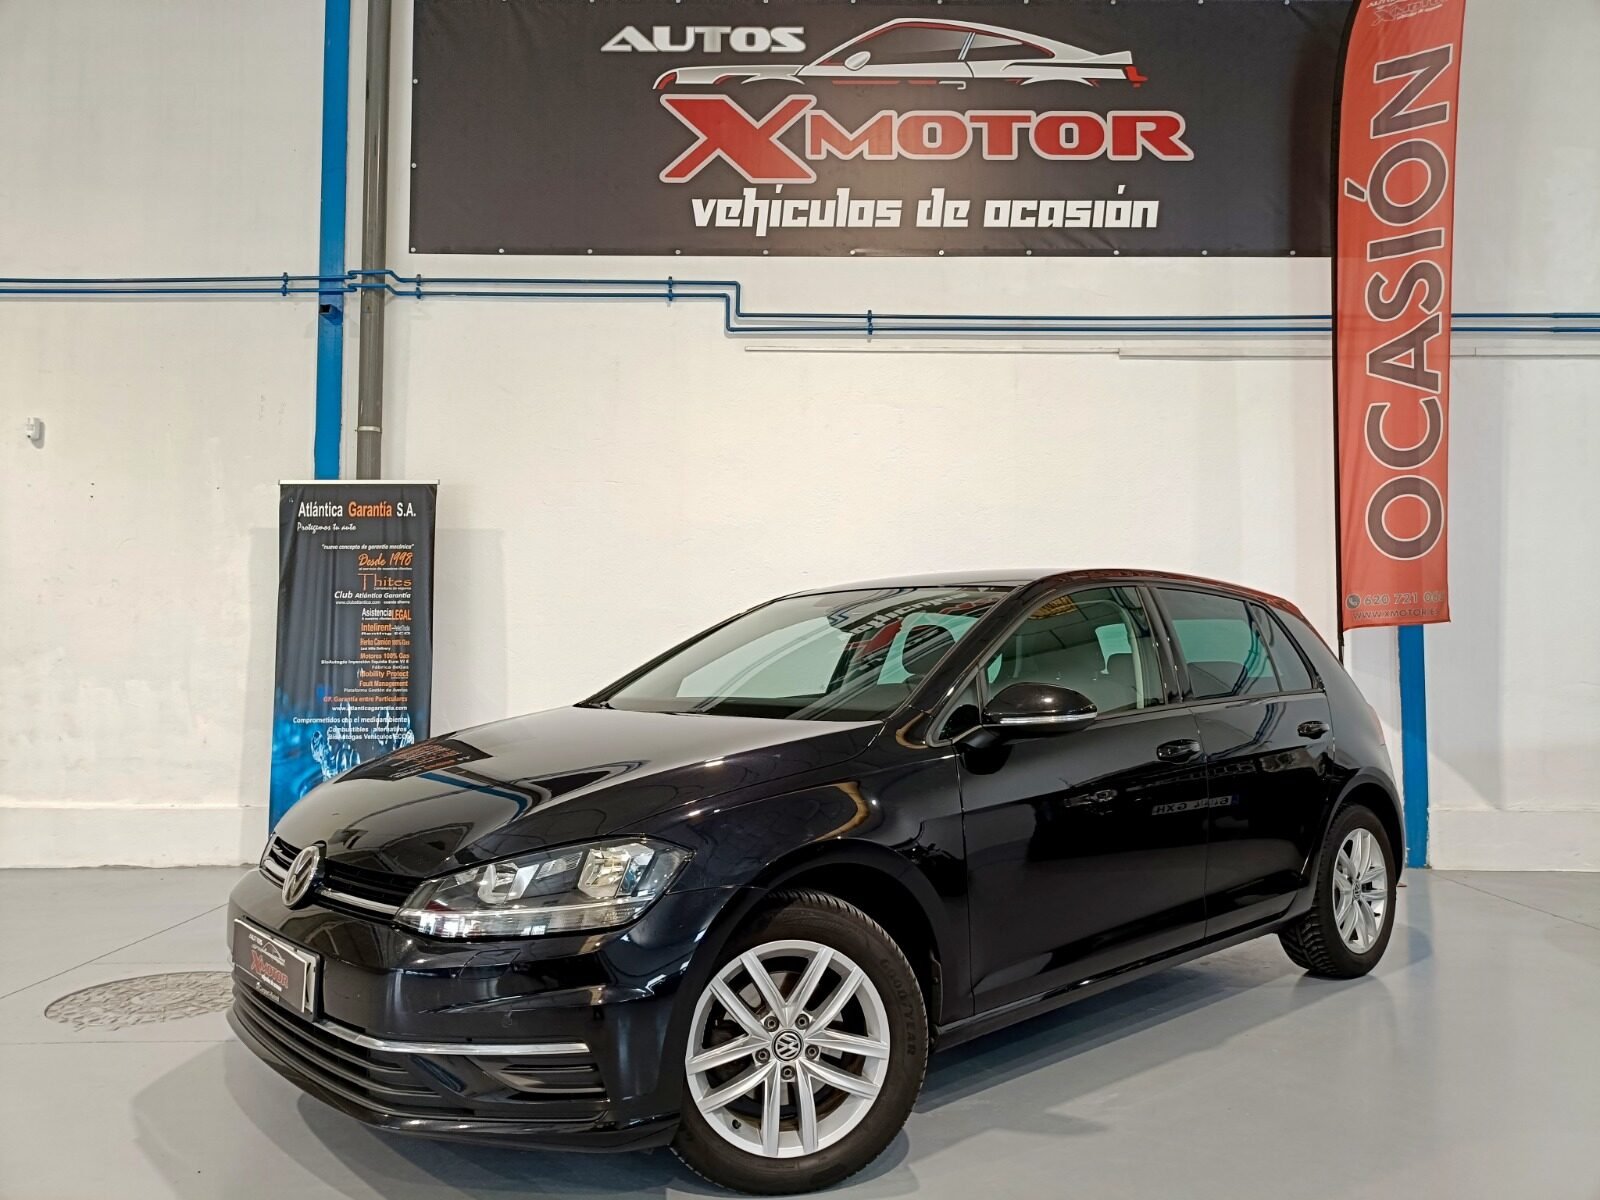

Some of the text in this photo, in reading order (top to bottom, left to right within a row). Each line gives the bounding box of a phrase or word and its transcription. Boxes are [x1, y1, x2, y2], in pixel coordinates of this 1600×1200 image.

[600, 26, 807, 54] AUTOS
[659, 93, 1195, 184] XMOTOR
[691, 184, 1160, 237] vehículos de ocasión
[1345, 43, 1454, 561] OCASIÓN
[298, 501, 417, 517] Atlántica Garantía S.A.
[358, 552, 413, 567] Desde 1998
[334, 591, 353, 599] Club
[383, 591, 411, 599] Garantía
[1364, 593, 1390, 606] 620
[1393, 591, 1418, 605] 721
[292, 716, 340, 724] Comprometidos
